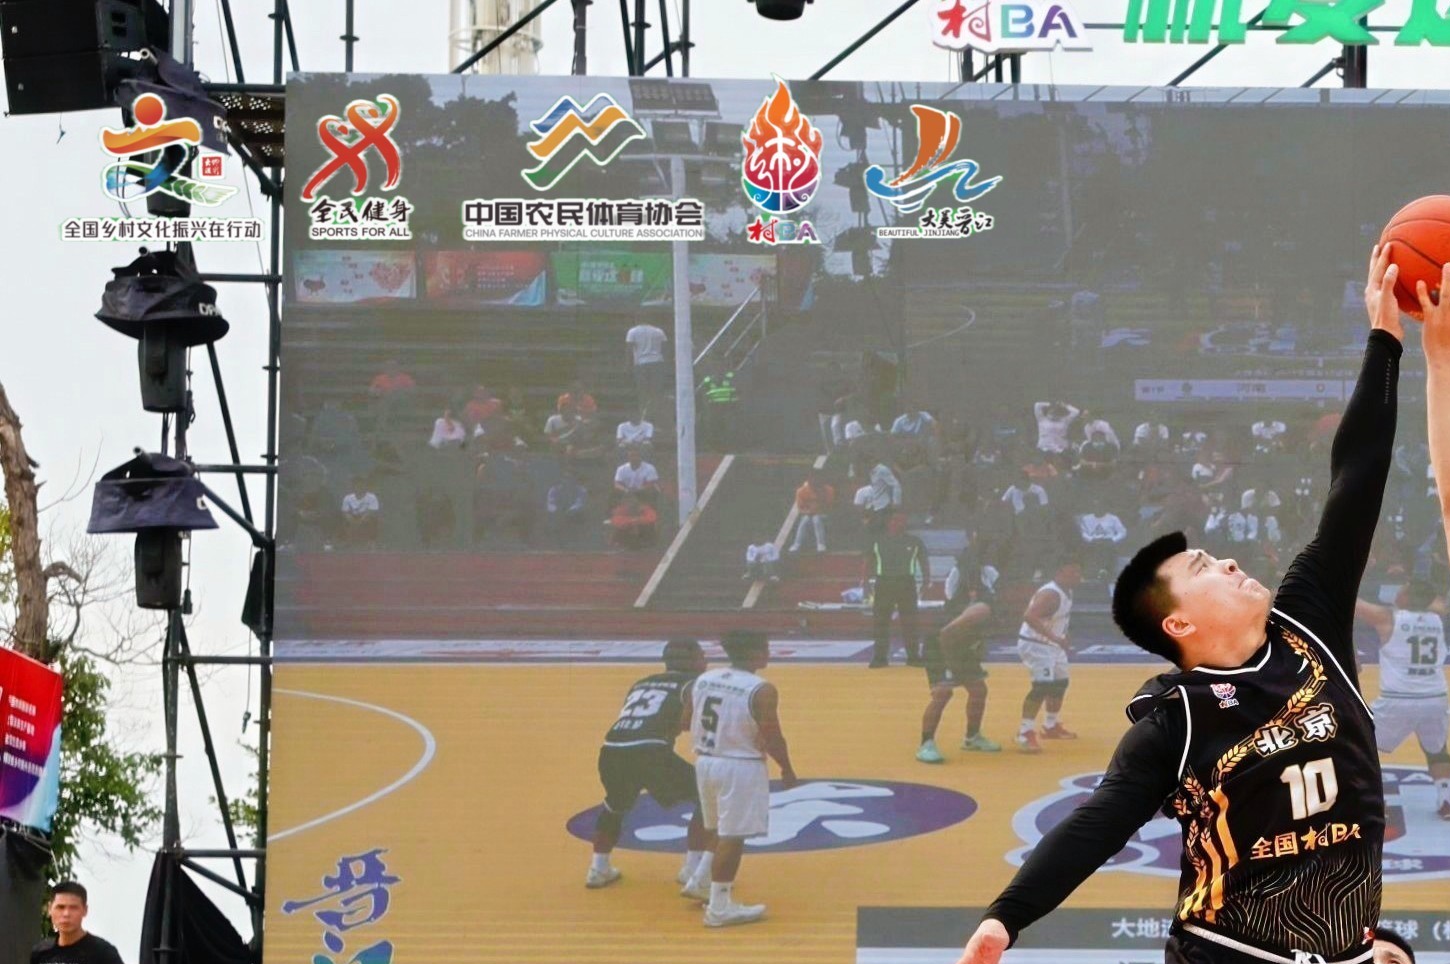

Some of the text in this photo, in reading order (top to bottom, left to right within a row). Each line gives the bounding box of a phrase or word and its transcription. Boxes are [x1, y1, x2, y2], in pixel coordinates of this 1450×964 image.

[936, 0, 1079, 42] 村BA
[1406, 635, 1438, 665] 13
[618, 689, 668, 718] 23
[701, 695, 723, 733] 5
[1255, 703, 1337, 757] 北京
[1279, 757, 1339, 820] 10
[1250, 822, 1361, 859] 全国村BA
